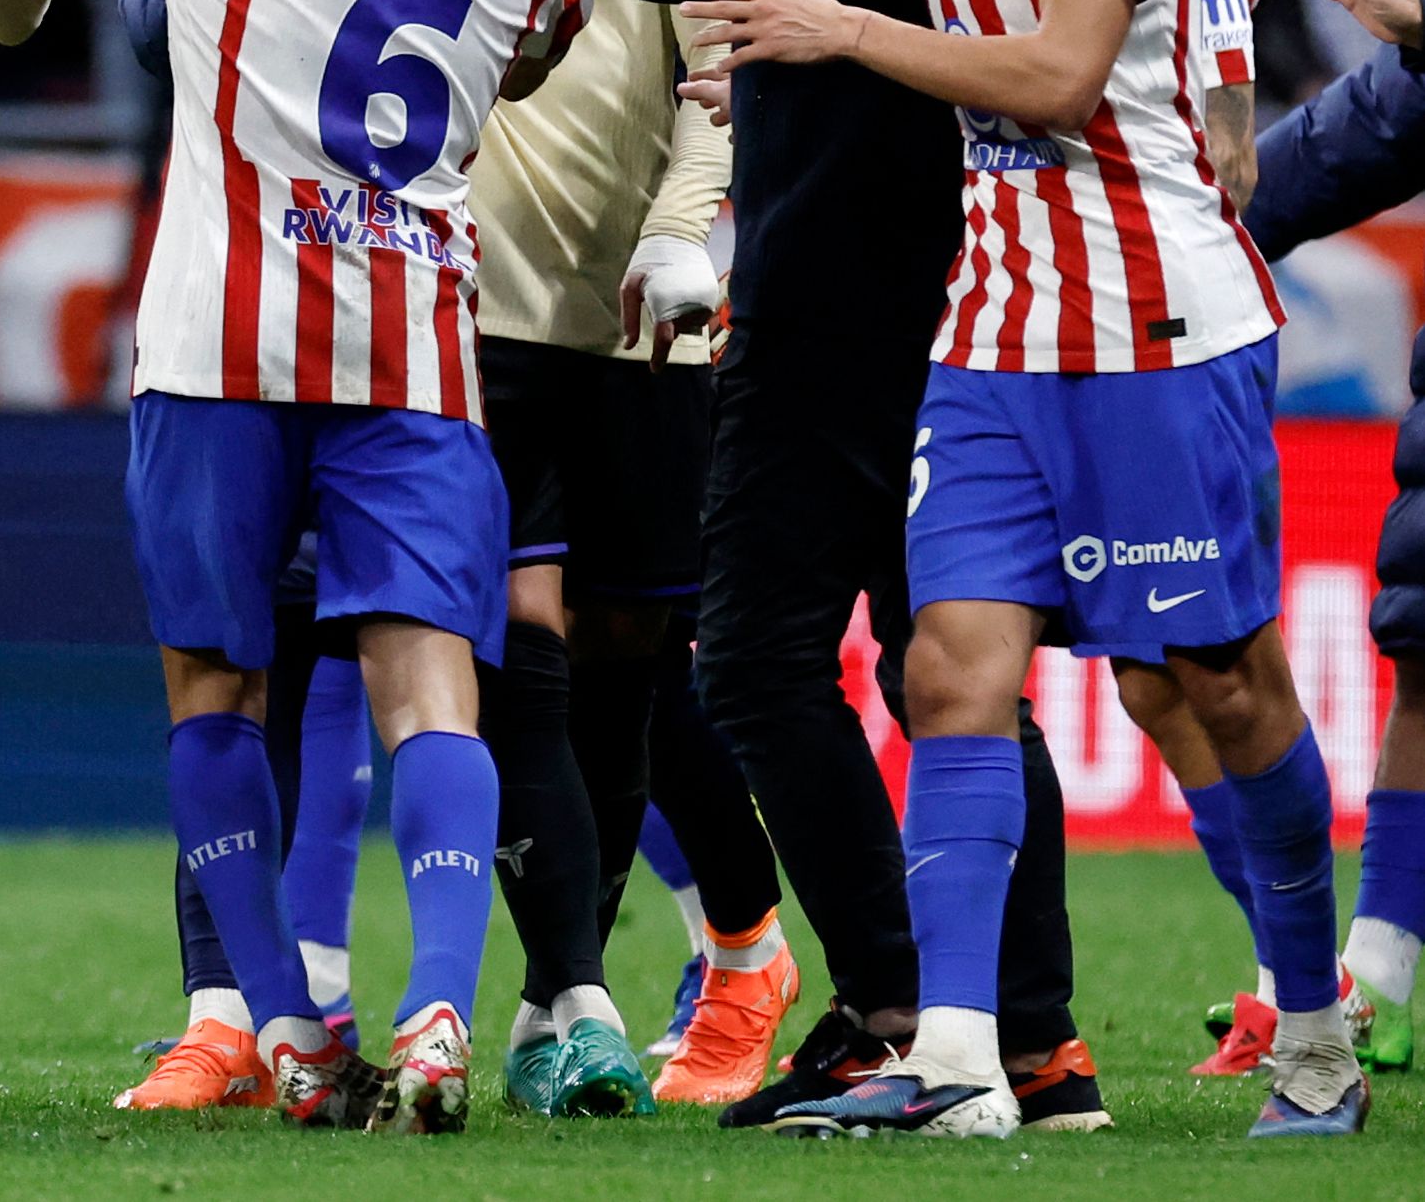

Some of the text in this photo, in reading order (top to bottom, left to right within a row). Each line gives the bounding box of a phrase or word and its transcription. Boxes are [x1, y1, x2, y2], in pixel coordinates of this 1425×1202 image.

[1202, 27, 1251, 50] raken
[1112, 536, 1221, 566] ComAve
[186, 829, 257, 873] ATLETI
[411, 849, 480, 879] ATLETI
